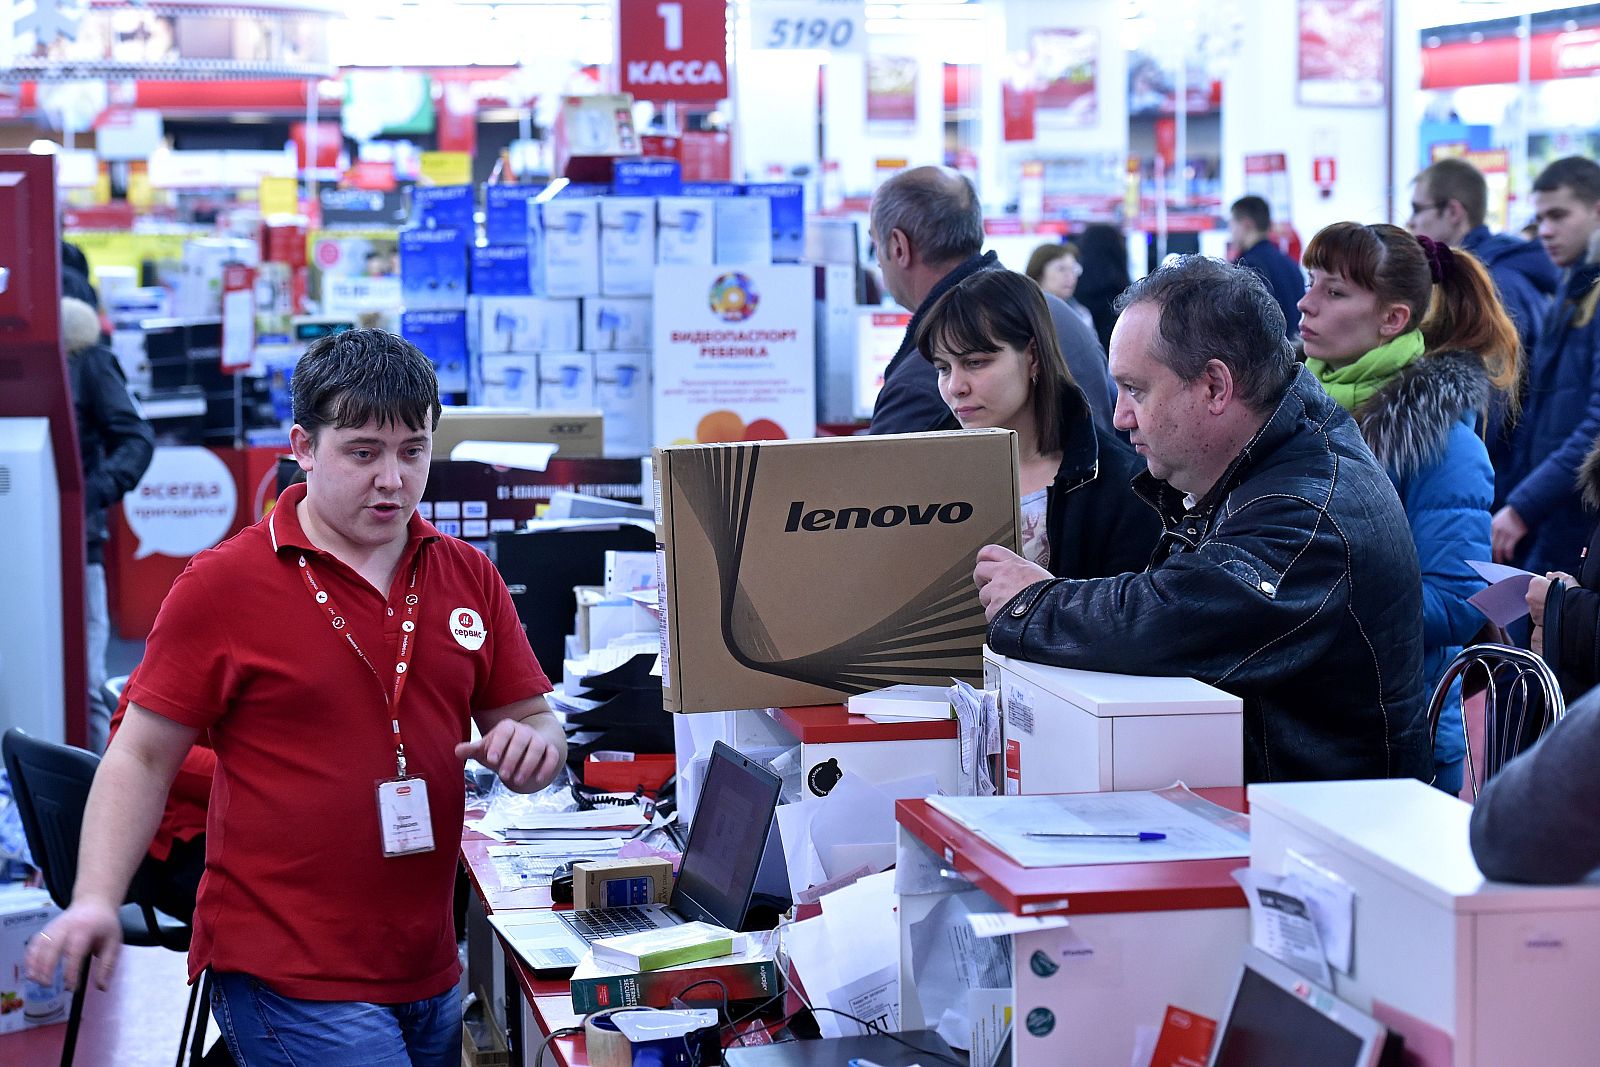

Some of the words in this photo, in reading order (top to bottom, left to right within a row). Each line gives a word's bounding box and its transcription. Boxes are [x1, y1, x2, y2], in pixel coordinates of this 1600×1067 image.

[656, 3, 683, 51] 1
[767, 17, 854, 49] 5190
[627, 60, 723, 85] КАССА
[670, 329, 798, 344] ВИДЕОПАСПОРТ
[550, 421, 588, 434] acer
[141, 482, 221, 500] всегда
[785, 501, 974, 532] lenovo
[454, 629, 483, 639] сервис
[623, 978, 632, 1007] SECURITY
[629, 978, 637, 1006] INTERNET
